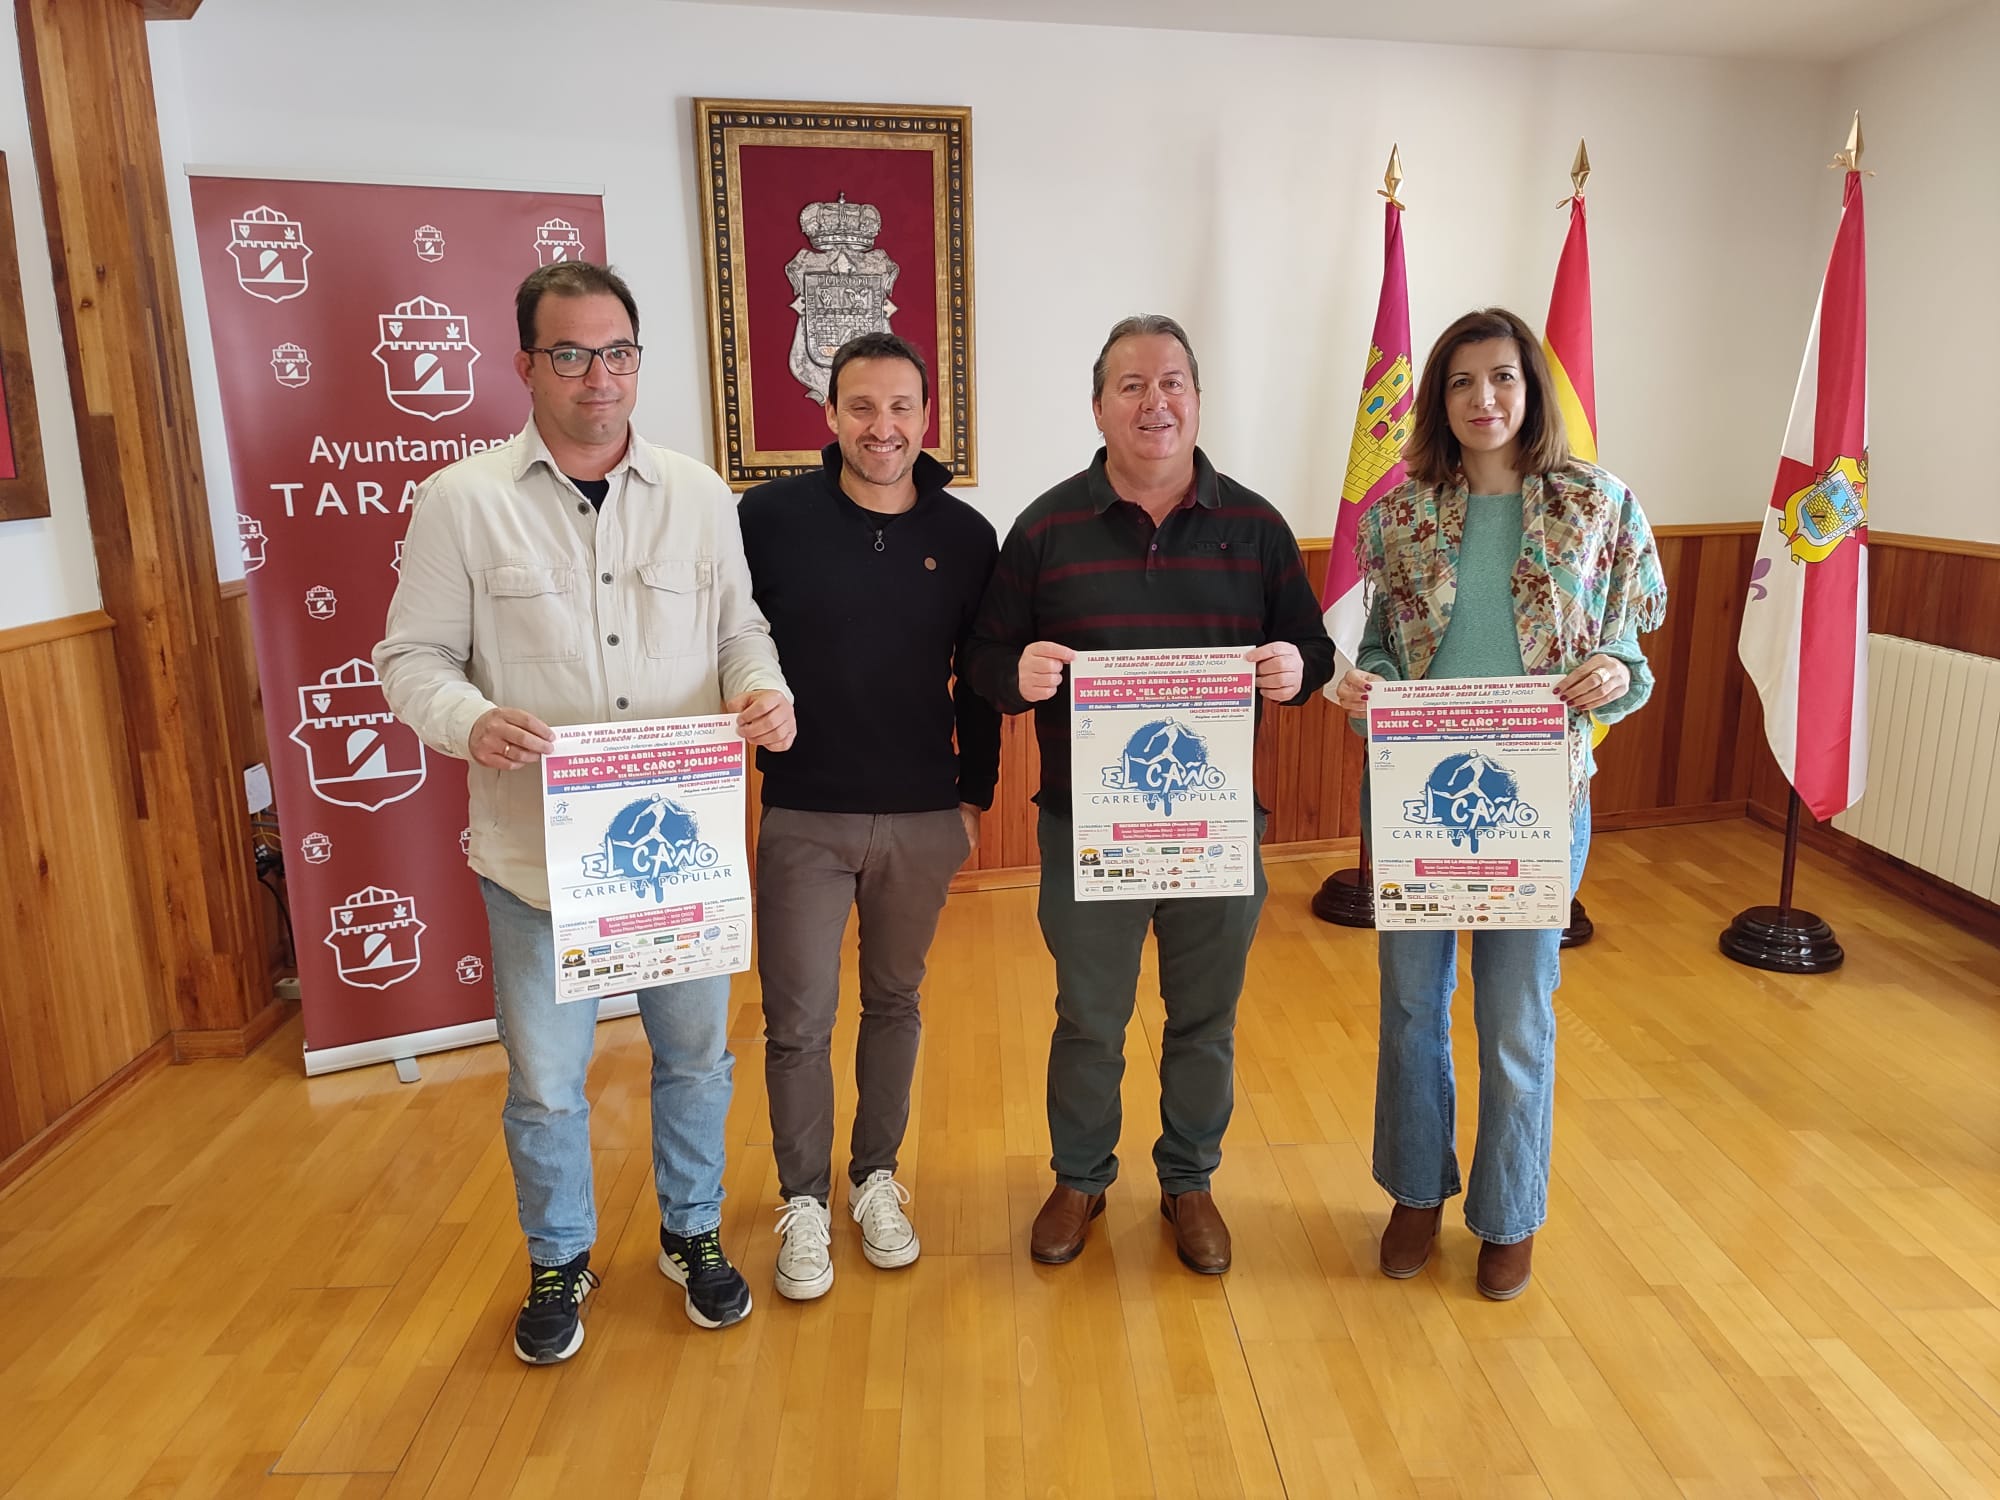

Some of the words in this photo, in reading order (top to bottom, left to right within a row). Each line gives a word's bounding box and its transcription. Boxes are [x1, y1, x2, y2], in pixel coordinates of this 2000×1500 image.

[309, 433, 515, 471] Ayuntamien
[270, 480, 416, 517] TARA
[1079, 689, 1110, 697] XXXIX
[1125, 688, 1136, 696] P.
[1377, 720, 1409, 728] XXXIX
[1412, 719, 1422, 727] C.
[1425, 719, 1436, 727] P.
[1439, 719, 1458, 727] "EL
[1460, 716, 1498, 726] CAÑO"
[1502, 716, 1563, 725] SOLISS-10K
[1391, 708, 1424, 717] SÁBADO,
[1503, 705, 1548, 713] TARANCÓN
[591, 733, 631, 743] TARANCÓN
[617, 724, 654, 734] PABELLÓN
[697, 720, 730, 728] MUESTRAS
[568, 753, 605, 765] SÁBADO,
[631, 751, 656, 759] ABRIL
[657, 749, 676, 757] 2024
[685, 743, 728, 754] TARANCÓN
[552, 767, 588, 779] XXXIX
[591, 766, 603, 775] C.
[606, 765, 618, 774] P.
[684, 753, 741, 766] SOLISS-10K
[1102, 750, 1138, 789] EL
[1145, 760, 1225, 794] CAÑO
[1092, 794, 1160, 804] CARRERA
[1169, 791, 1237, 801] POPULAR
[1403, 783, 1442, 824] EL
[1450, 796, 1539, 830] CAÑO
[1393, 830, 1466, 839] CARRERA
[1476, 830, 1551, 839] POPULAR
[582, 835, 624, 878] EL
[632, 838, 718, 881] CAÑO
[573, 881, 650, 899] CARRERA
[660, 868, 732, 886] POPULAR
